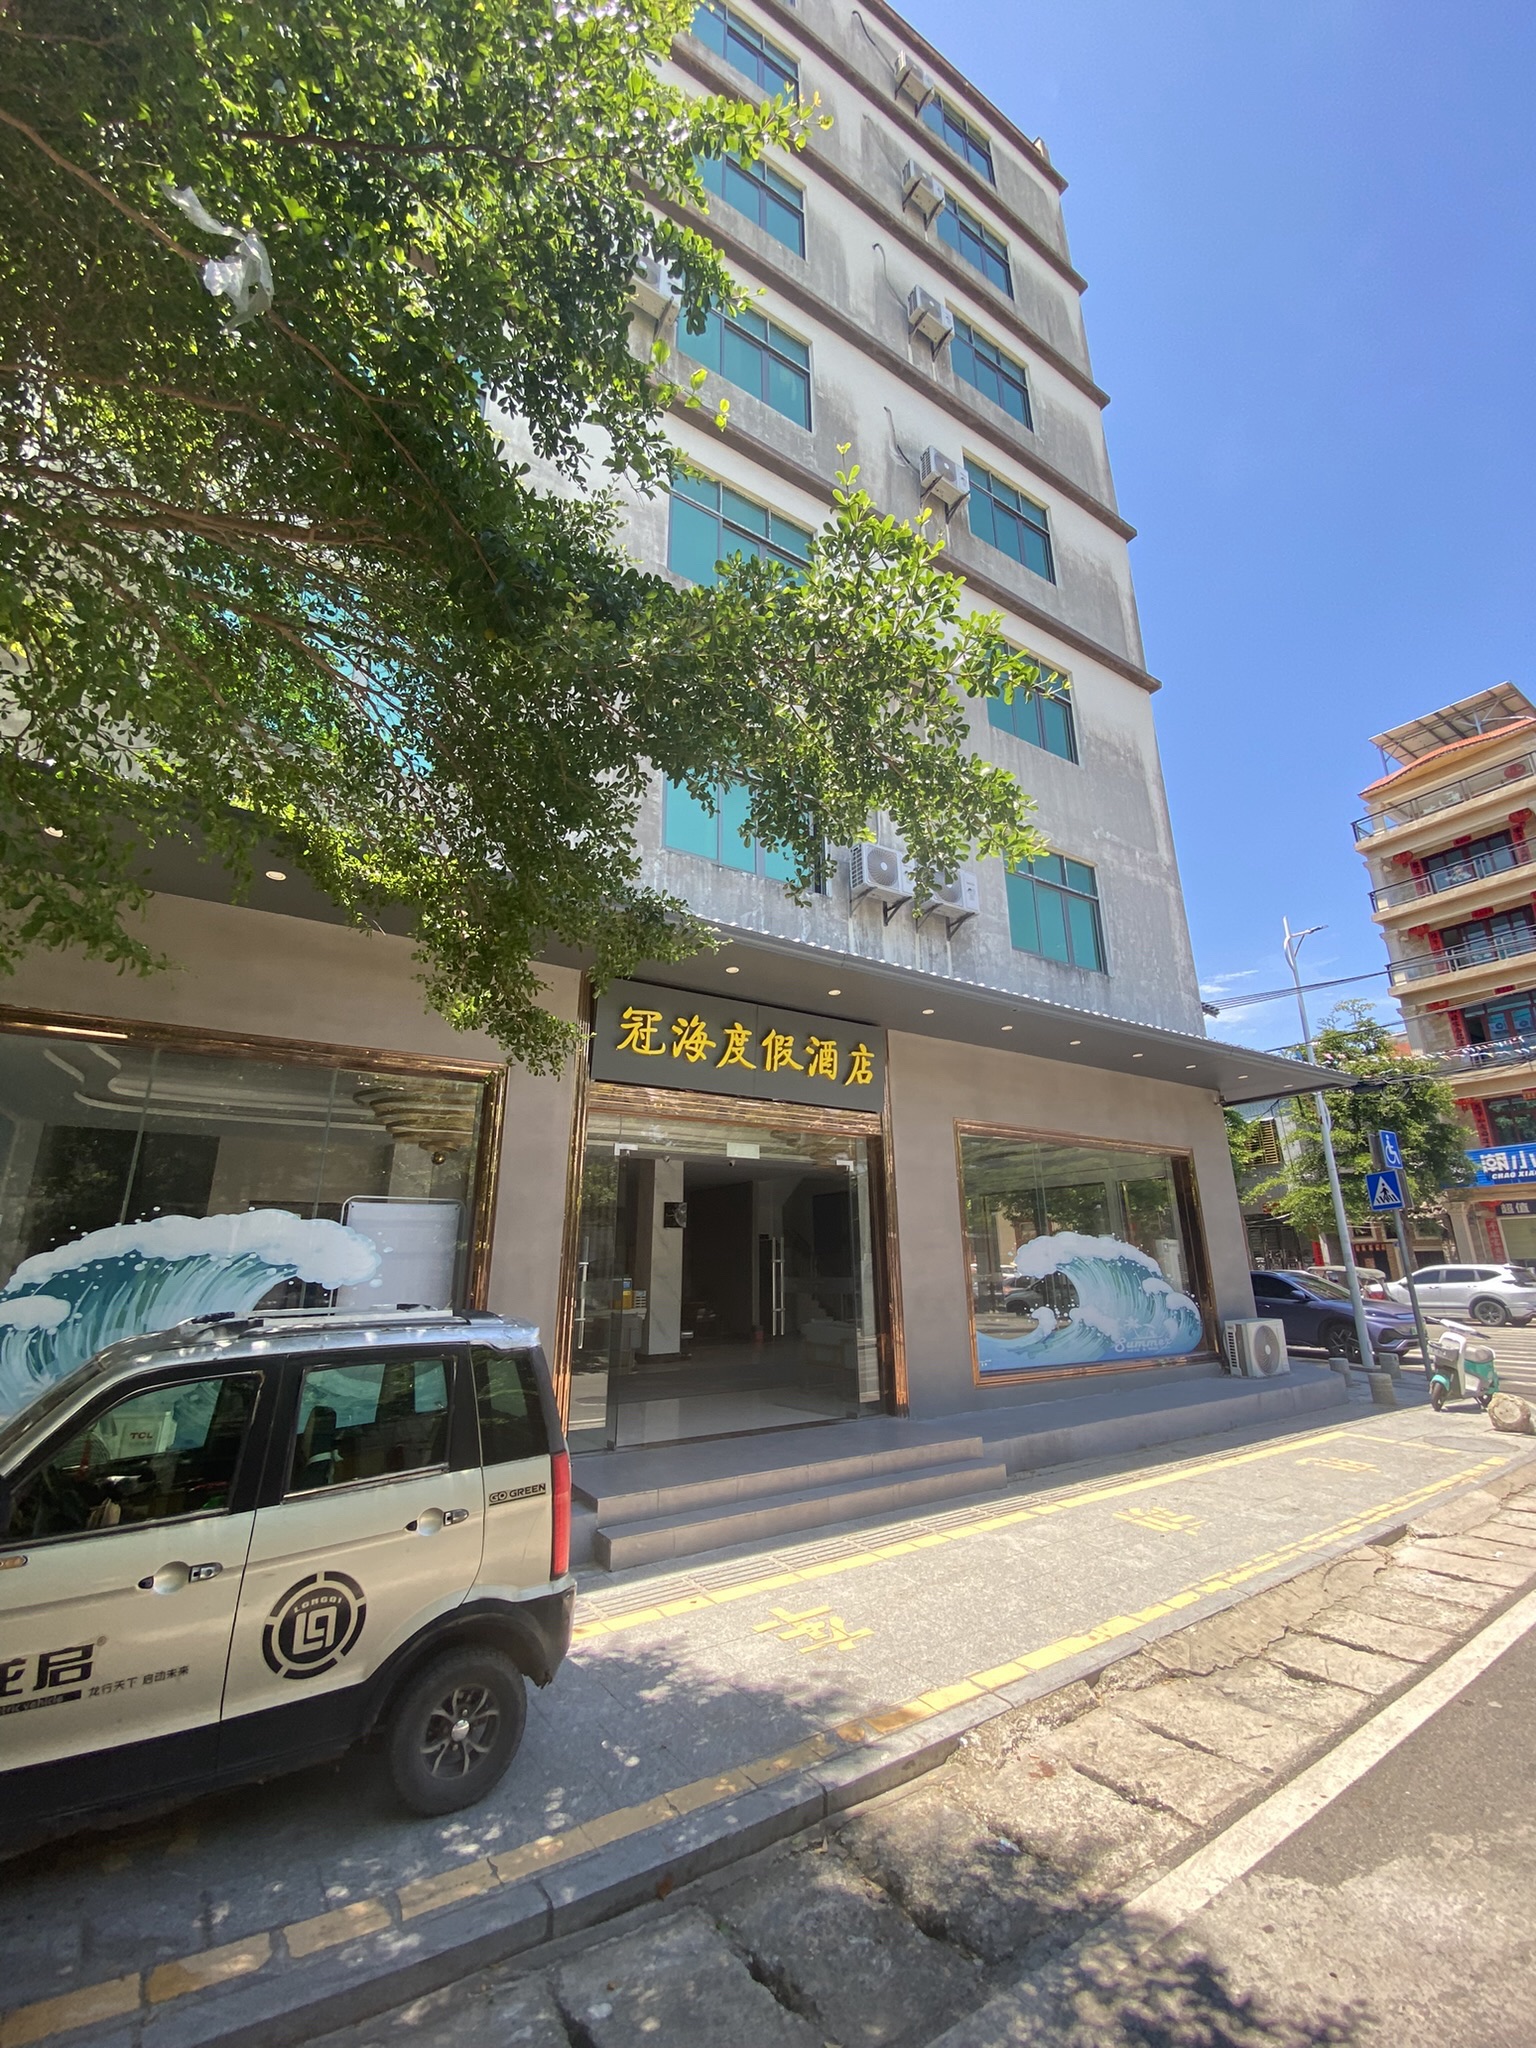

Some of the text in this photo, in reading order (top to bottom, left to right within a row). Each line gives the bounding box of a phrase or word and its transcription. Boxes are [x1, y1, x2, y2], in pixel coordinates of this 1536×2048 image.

[617, 1006, 875, 1087] 冠海度假酒店
[1491, 1169, 1536, 1180] CHAO XIA
[130, 1431, 153, 1440] TCL
[488, 1482, 547, 1503] GO GREEN
[88, 1665, 190, 1699] 龙行天下 启动未来
